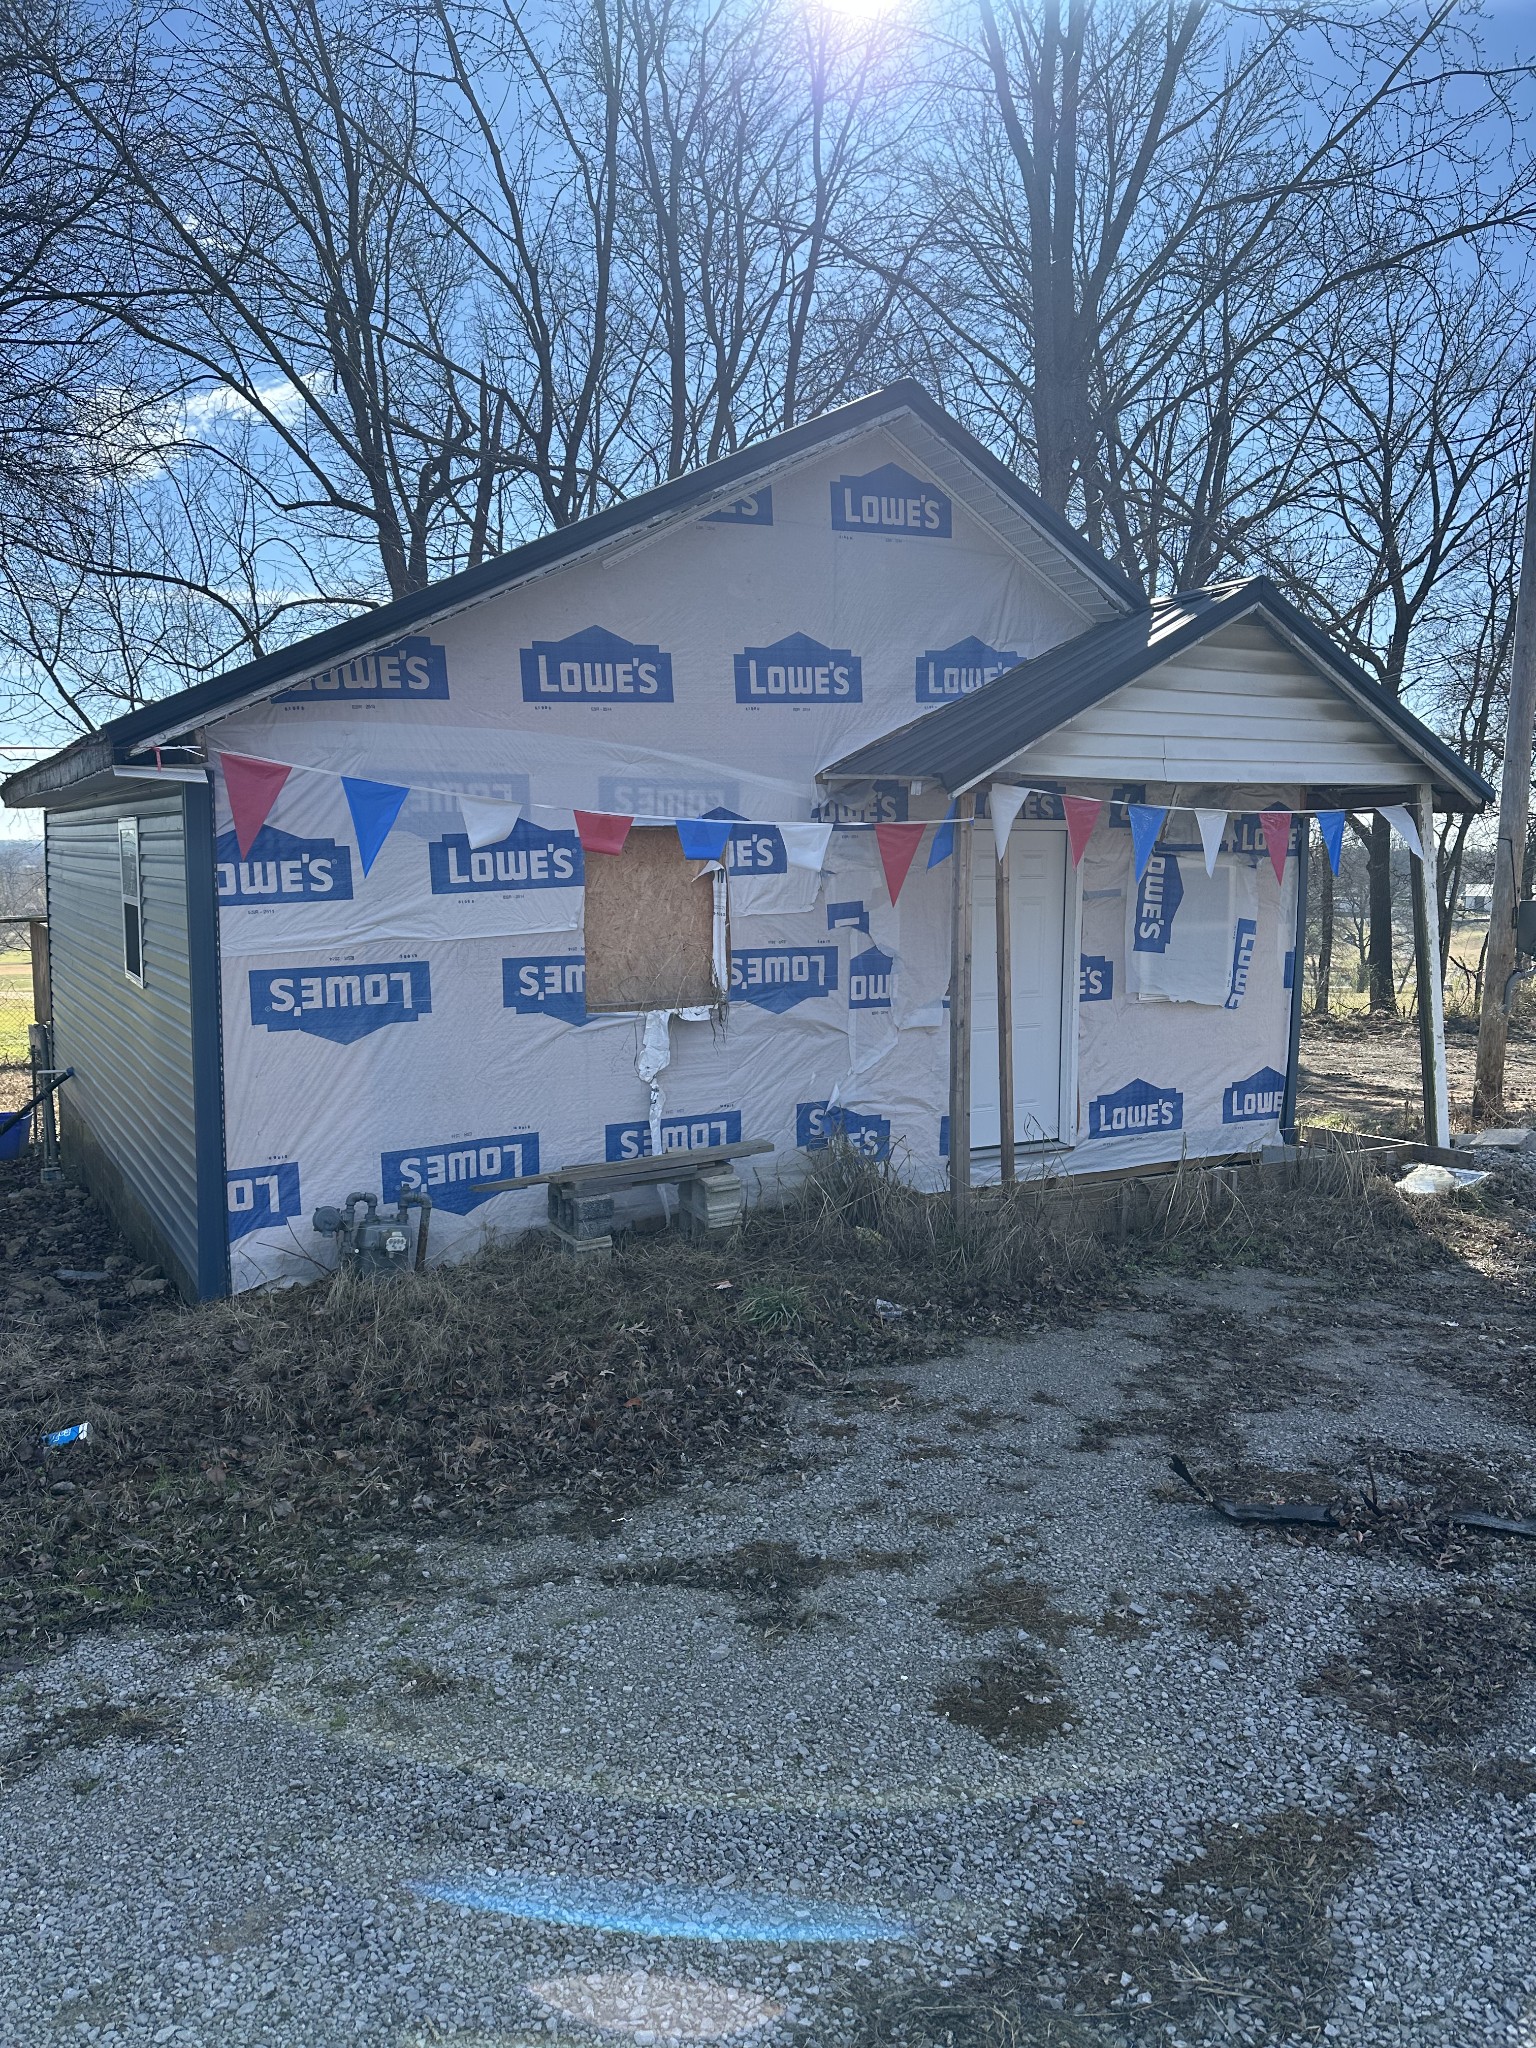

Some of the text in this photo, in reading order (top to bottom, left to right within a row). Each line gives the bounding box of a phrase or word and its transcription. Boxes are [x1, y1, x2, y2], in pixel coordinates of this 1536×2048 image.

[843, 487, 941, 530] LOWE'S
[289, 649, 431, 691] OWE'S
[537, 653, 660, 695] LOWE'S
[749, 659, 851, 695] LOWE'S
[448, 842, 575, 884] LOWE'S
[731, 955, 826, 991] LOWE'S
[268, 972, 413, 1017] LOWE'S
[1099, 1098, 1174, 1131] LOWE'S
[399, 1144, 522, 1194] LOWE'S
